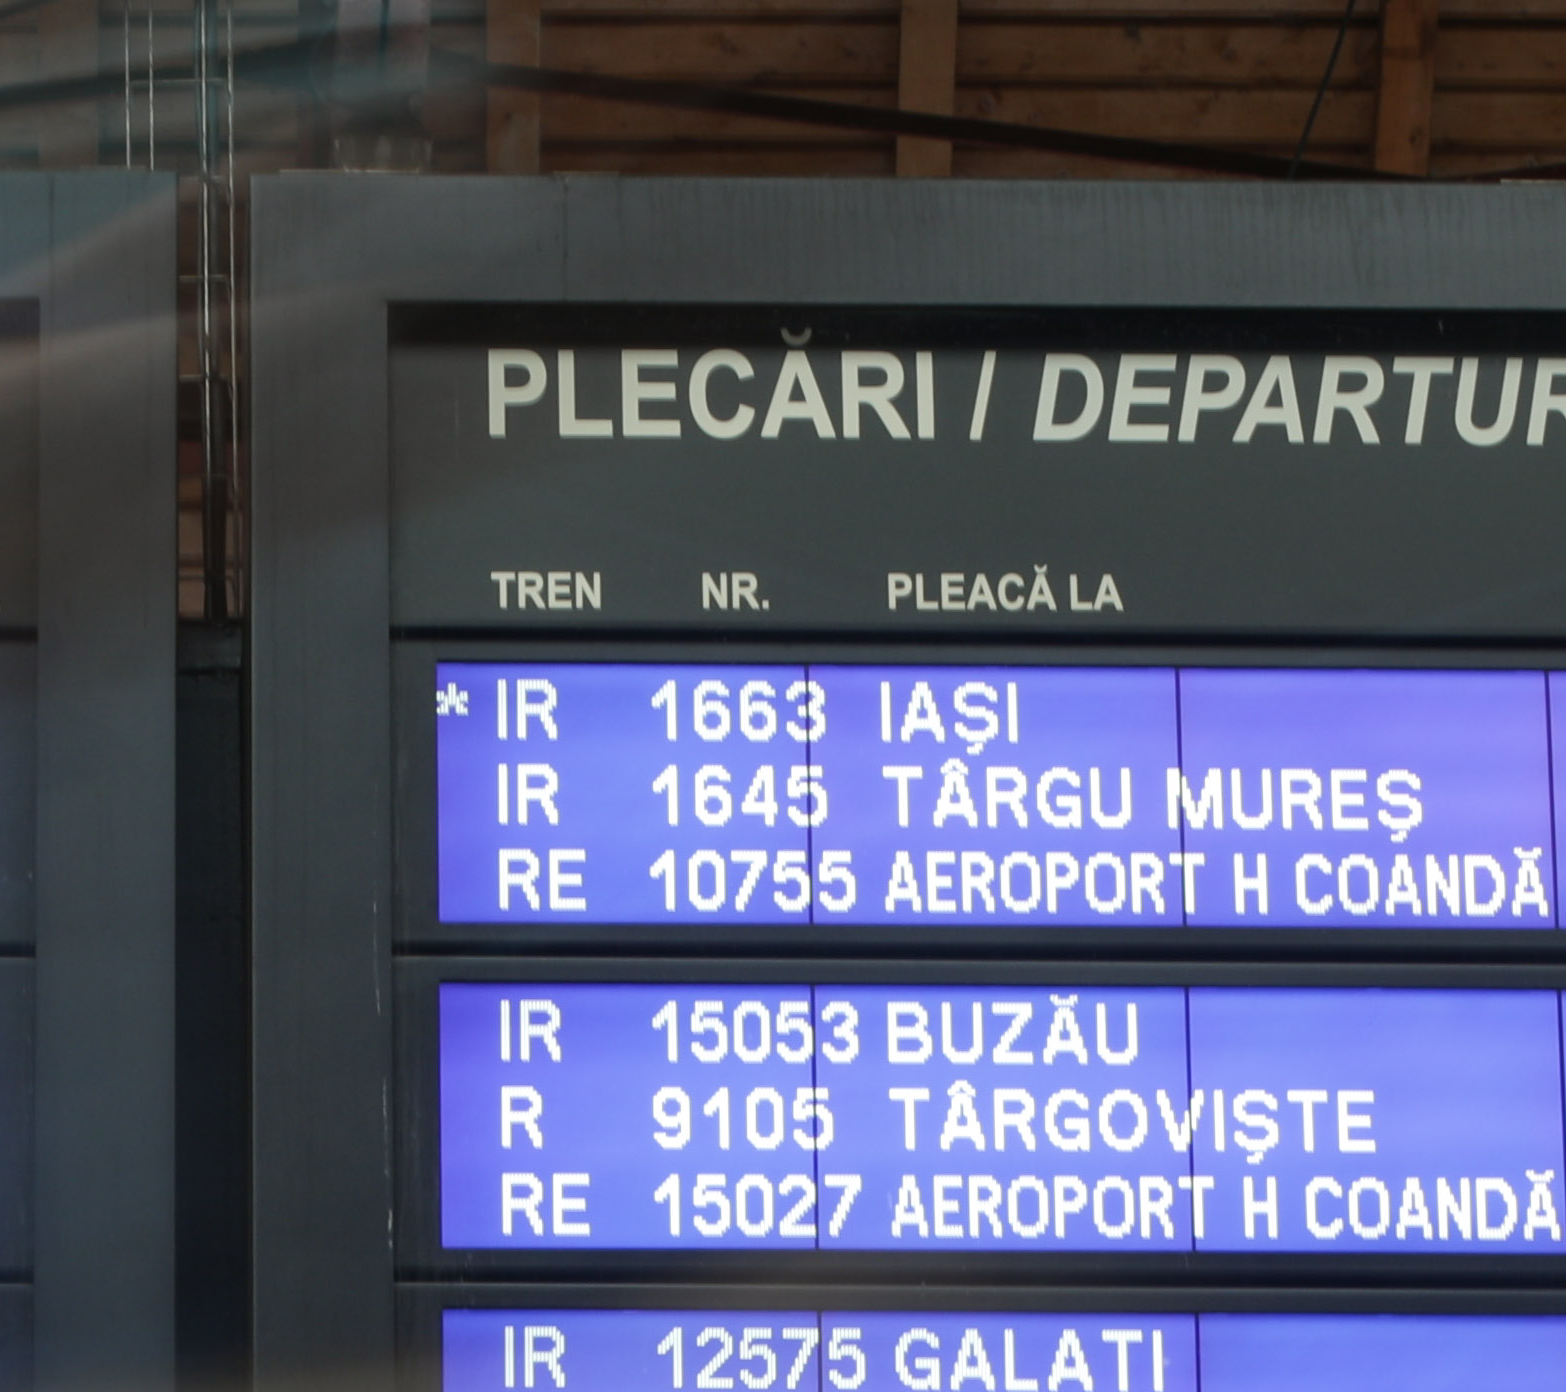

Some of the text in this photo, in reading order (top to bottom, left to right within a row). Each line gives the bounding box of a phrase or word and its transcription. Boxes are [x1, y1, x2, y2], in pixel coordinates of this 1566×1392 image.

[486, 327, 935, 441] PLECĂRI
[490, 571, 602, 611] TREN
[700, 571, 772, 611] NR.
[886, 565, 1125, 613] PLEACĂ LA
[497, 679, 558, 740] IR
[651, 679, 826, 742] 1663
[498, 763, 559, 825] IR
[652, 764, 828, 827] 1645
[882, 757, 1132, 829] TÂRGU
[498, 848, 587, 910] RE
[649, 849, 857, 912] 10755
[884, 850, 1205, 914] AEROPORT
[1233, 852, 1269, 915] H
[1295, 846, 1549, 916] COANDĂ
[500, 999, 561, 1062] IR
[652, 1000, 859, 1064] 15053
[887, 994, 1139, 1065] BUZĂU
[501, 1085, 543, 1149] R
[652, 1086, 834, 1151] 9105
